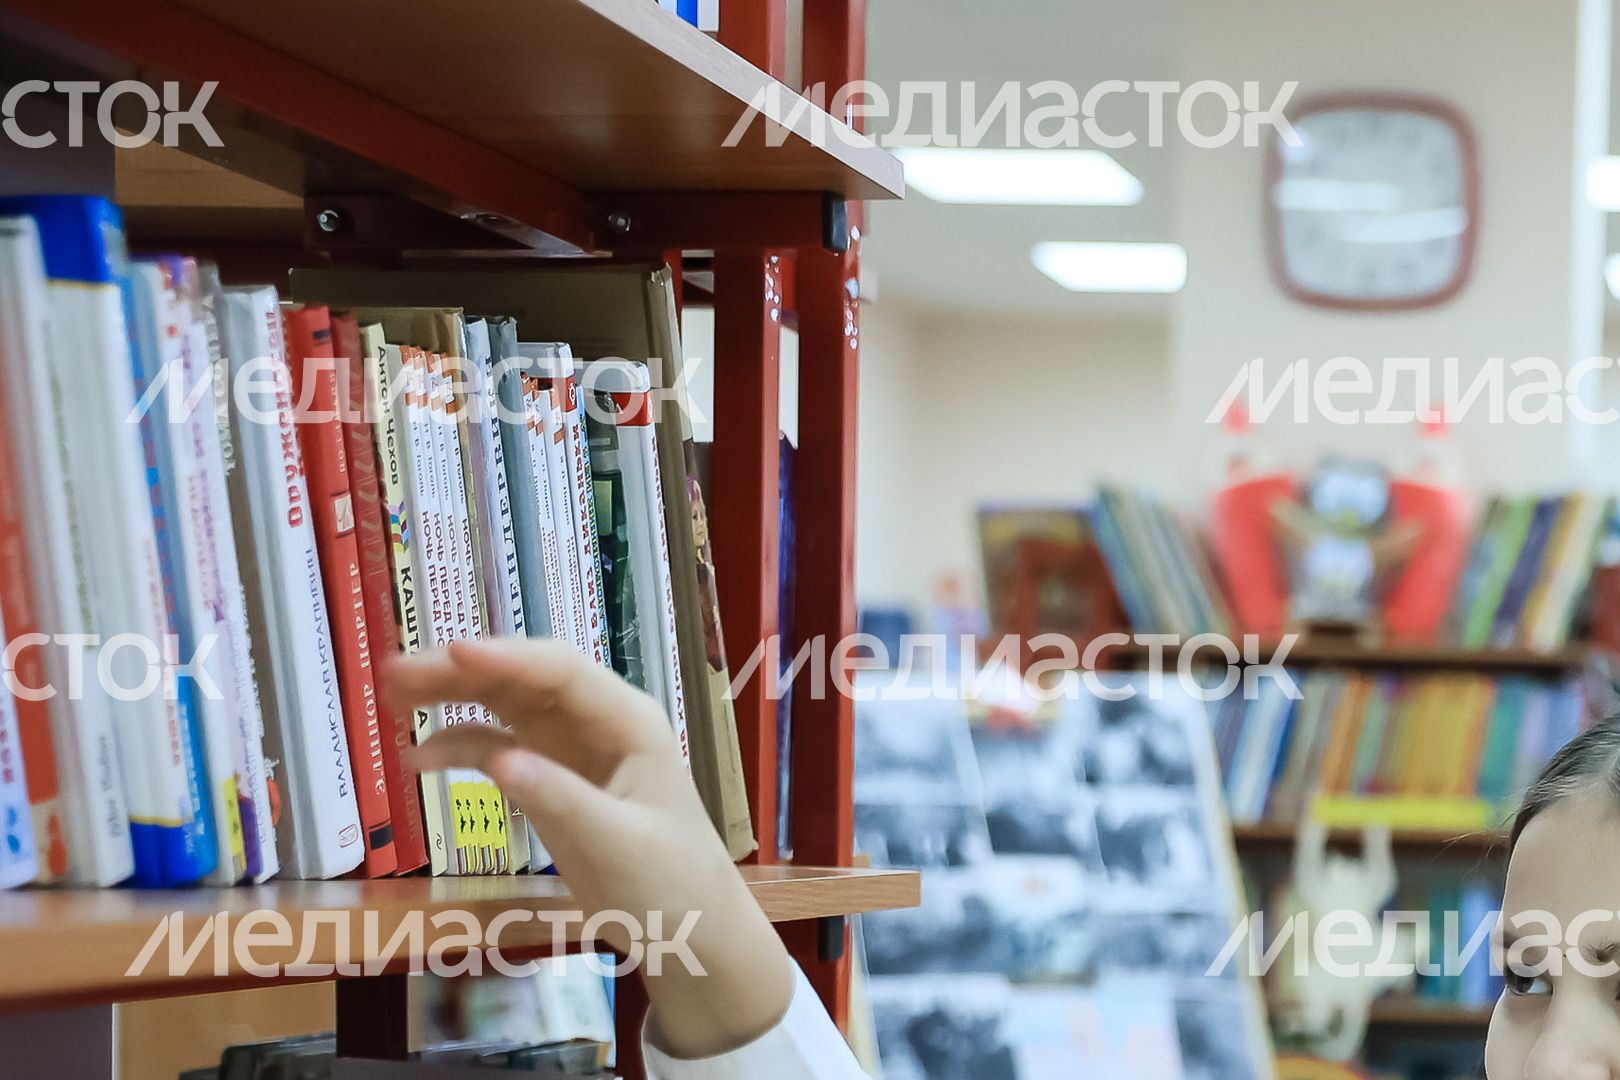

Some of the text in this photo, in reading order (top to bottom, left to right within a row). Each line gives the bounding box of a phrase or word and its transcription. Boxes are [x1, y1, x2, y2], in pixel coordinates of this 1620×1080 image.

[375, 344, 401, 486] Антон Чехов
[415, 453, 426, 497] Гоголь
[426, 455, 437, 499] Гоголь
[439, 457, 451, 501] Гоголь
[455, 462, 465, 505] Гоголь
[420, 509, 443, 622] НОЧЬ ПЕРЕД
[431, 512, 445, 562] НОЧЬ
[445, 513, 458, 564] НОЧЬ
[437, 565, 452, 624] ПЕРЕД
[451, 566, 465, 625] ПЕРЕД
[460, 516, 472, 566] НОЧЬ
[466, 569, 479, 627] ПЕРЕД
[347, 559, 387, 795] ЭЛИНОР ПОРТЕР
[398, 566, 429, 730] КАШТА
